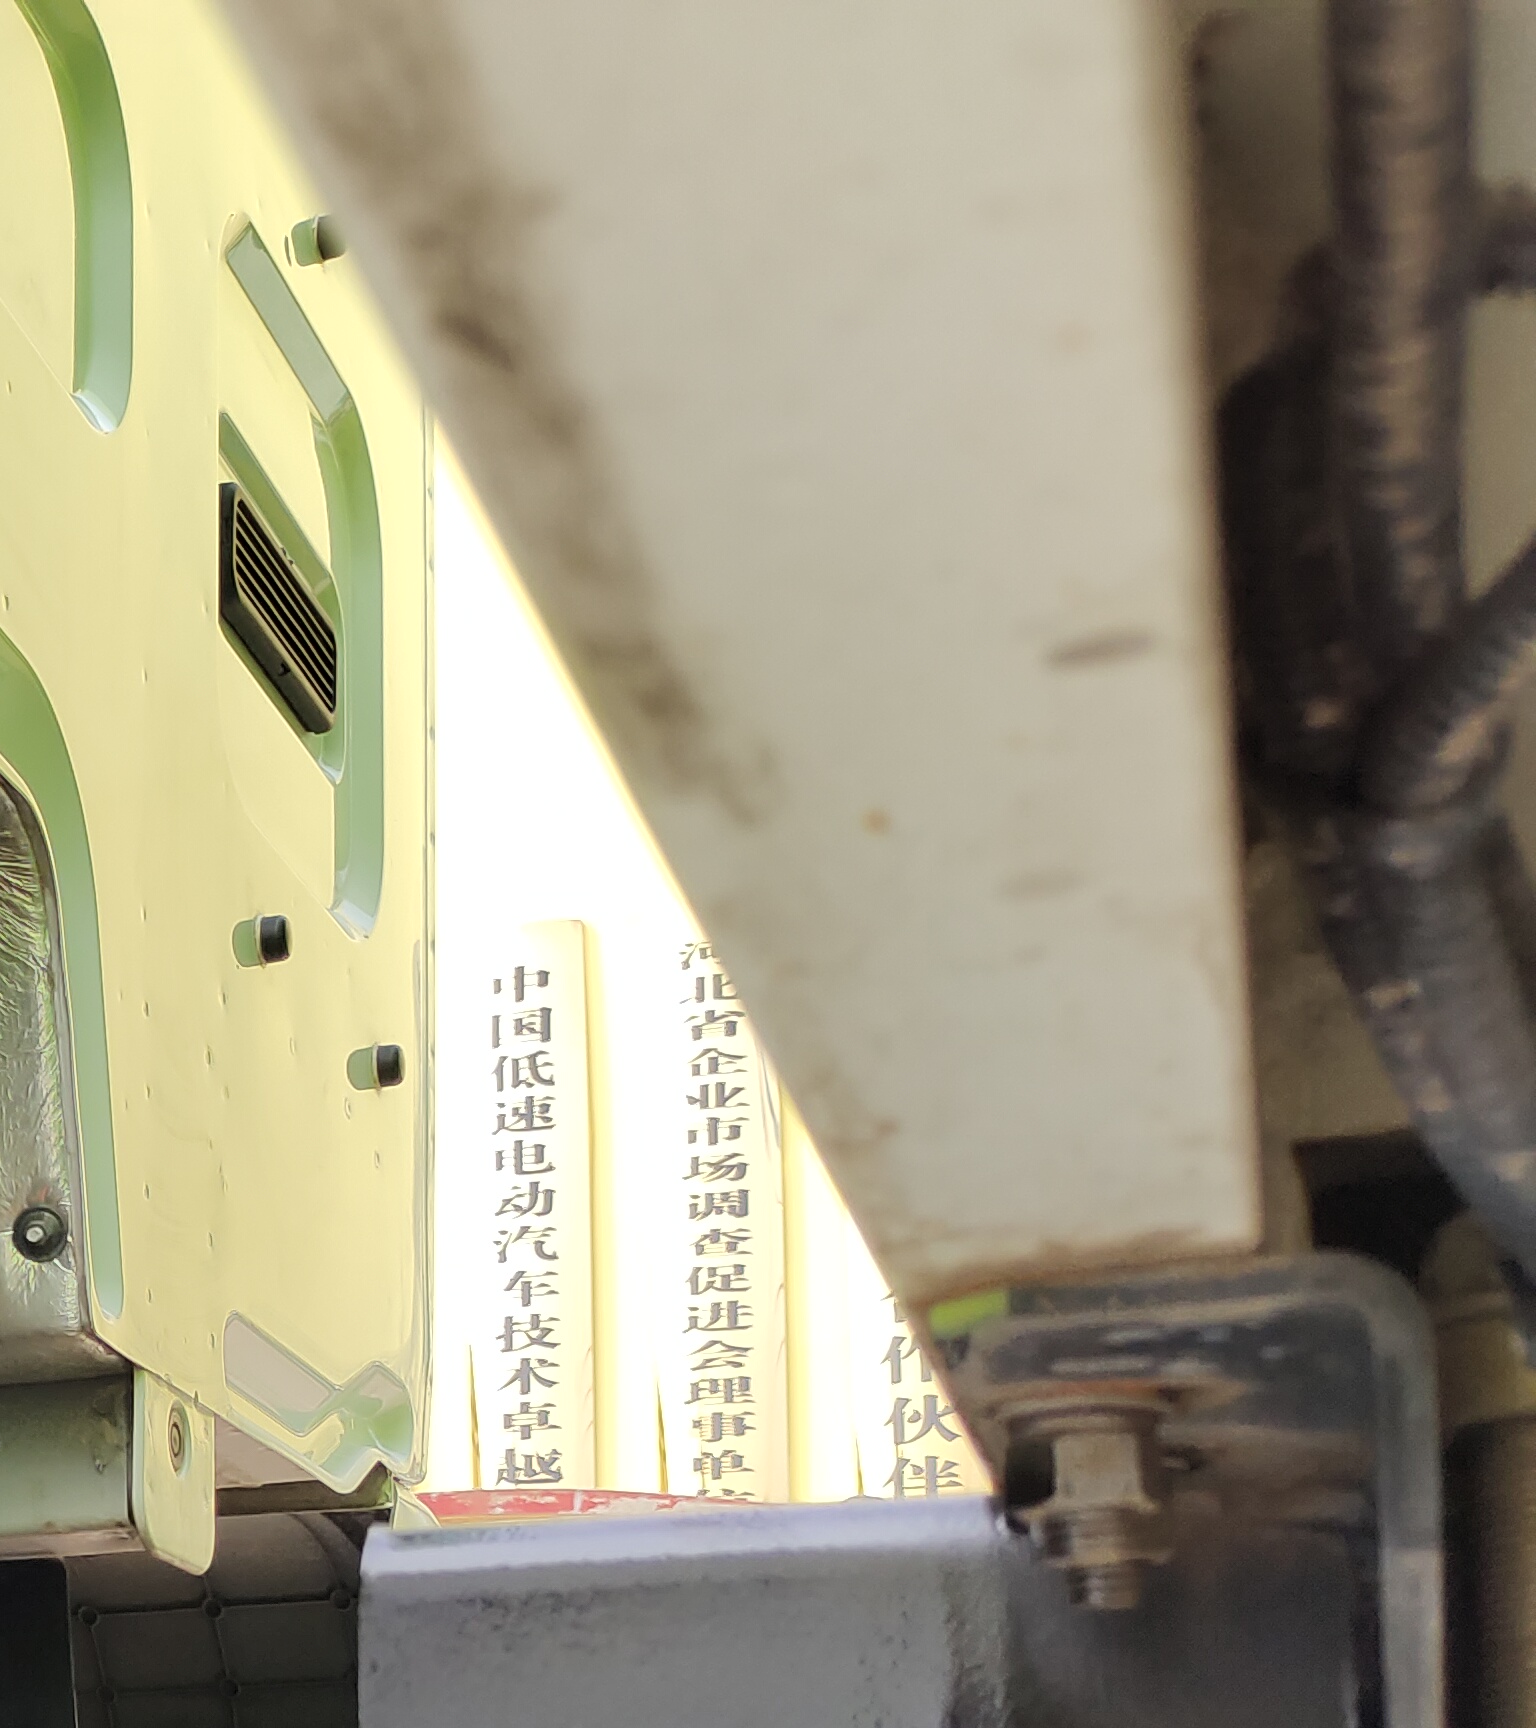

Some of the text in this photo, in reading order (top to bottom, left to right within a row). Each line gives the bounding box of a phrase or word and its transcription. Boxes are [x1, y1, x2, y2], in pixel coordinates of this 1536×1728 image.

[491, 965, 564, 1487] 中国低速电动汽车技术卓越
